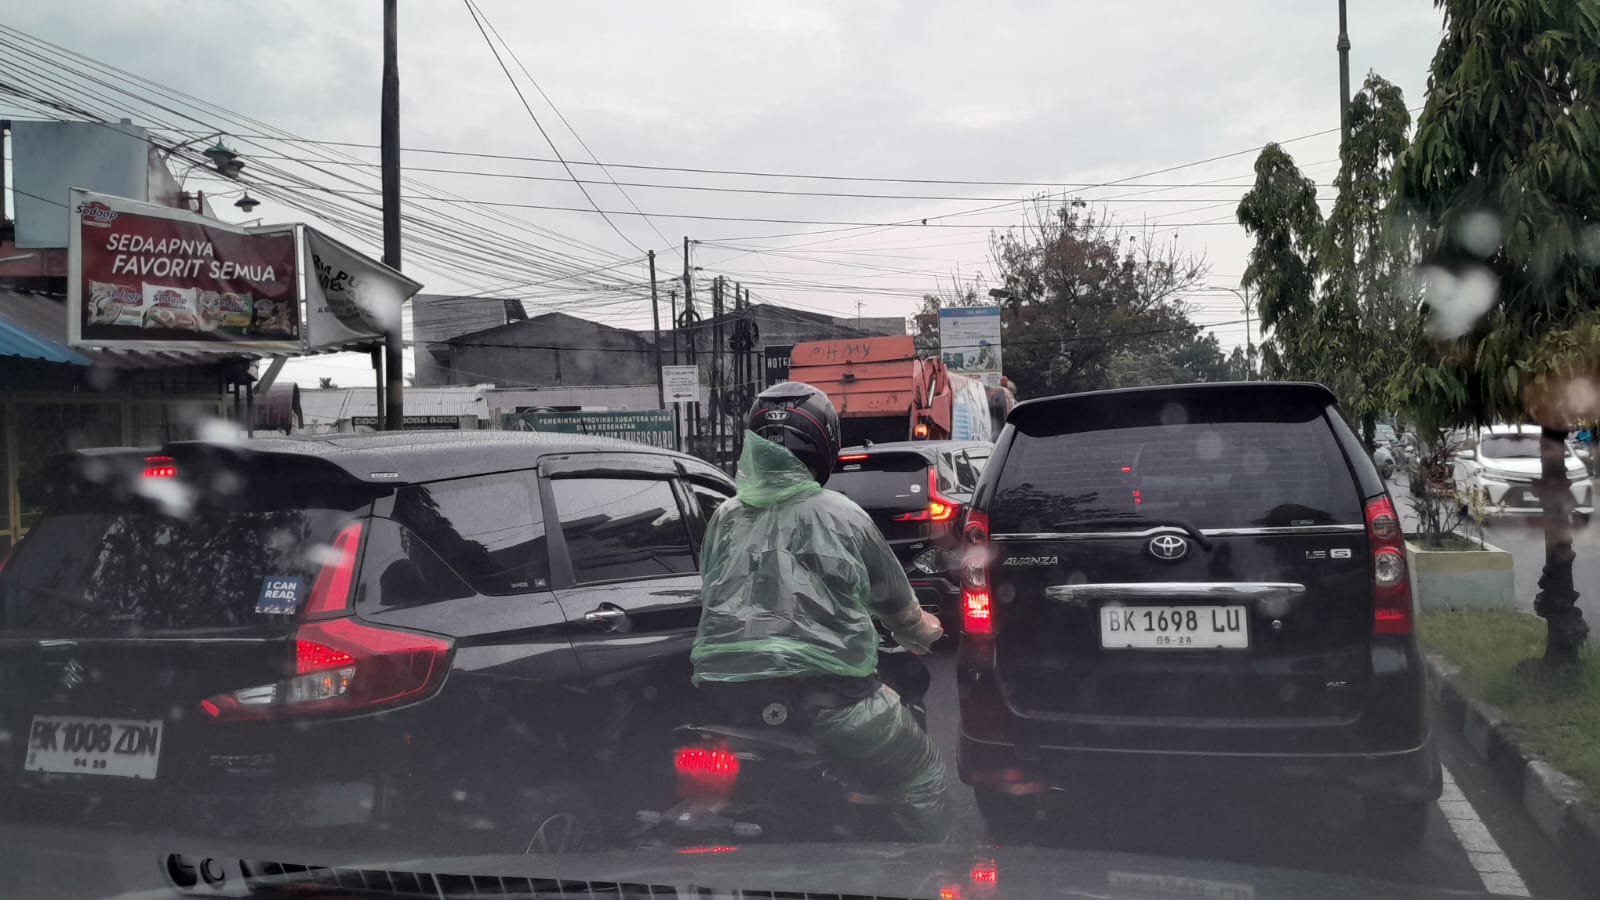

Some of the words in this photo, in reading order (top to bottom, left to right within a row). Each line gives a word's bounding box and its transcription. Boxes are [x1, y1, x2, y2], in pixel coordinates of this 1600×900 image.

[106, 233, 214, 257] SEDAAPNYA
[112, 255, 204, 278] FAVORIT
[209, 261, 276, 282] SEMUA
[539, 417, 581, 425] PEMERINTAH
[767, 412, 788, 420] KYT
[652, 430, 674, 449] PARU
[1002, 556, 1058, 566] AVANZA
[267, 581, 272, 590] I
[272, 581, 297, 591] CAN
[1109, 610, 1136, 632] BK
[1143, 610, 1198, 632] 1698
[1212, 609, 1241, 632] LU
[30, 721, 60, 751] BK
[62, 722, 112, 753] 1008
[113, 724, 159, 756] ZDN
